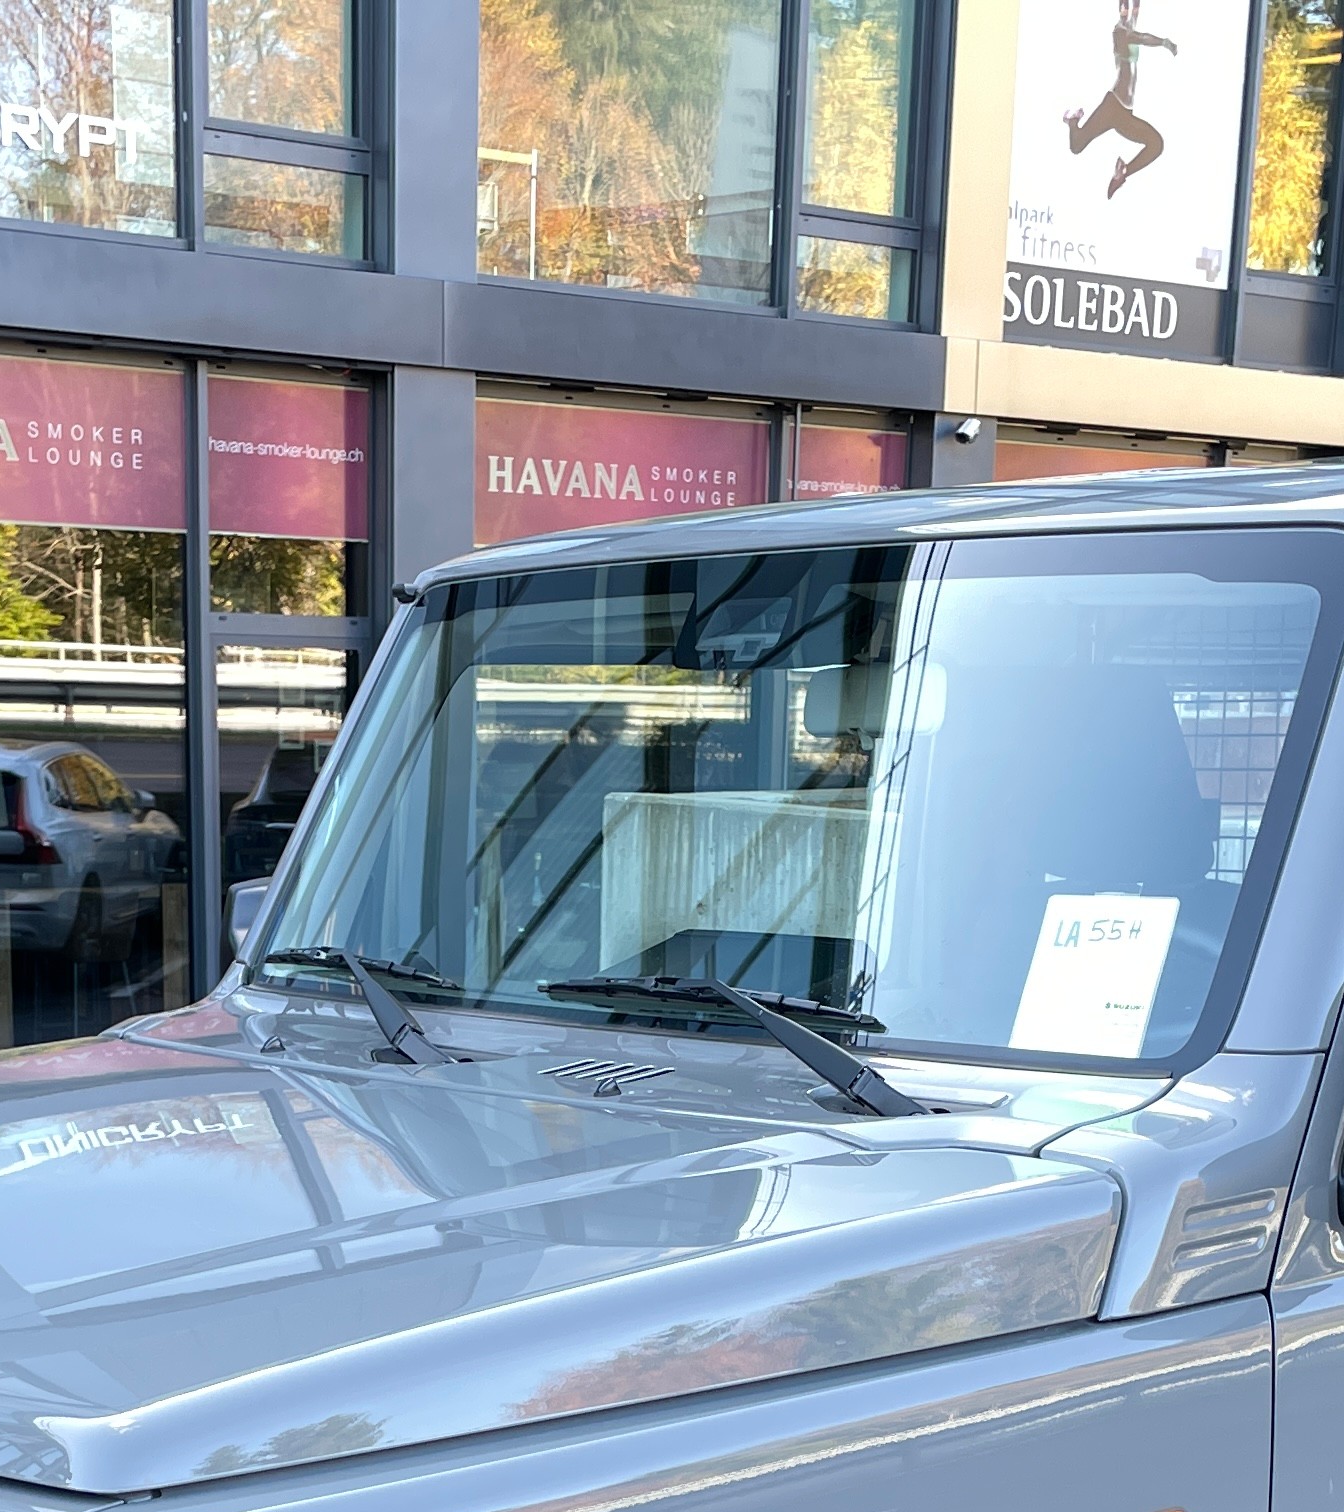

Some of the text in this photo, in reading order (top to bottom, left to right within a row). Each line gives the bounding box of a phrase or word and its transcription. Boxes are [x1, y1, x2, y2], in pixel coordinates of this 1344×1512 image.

[1021, 225, 1097, 265] fitness
[1002, 271, 1178, 340] SOLEBAD
[27, 420, 145, 446] SMOKER
[28, 446, 144, 470] LOUNGE
[208, 435, 364, 464] havana-smoker-lounge.ch
[487, 455, 645, 502] HAVANA
[650, 465, 738, 486] SMOKER
[650, 486, 736, 507] LOUNGE
[1053, 919, 1081, 948] LA
